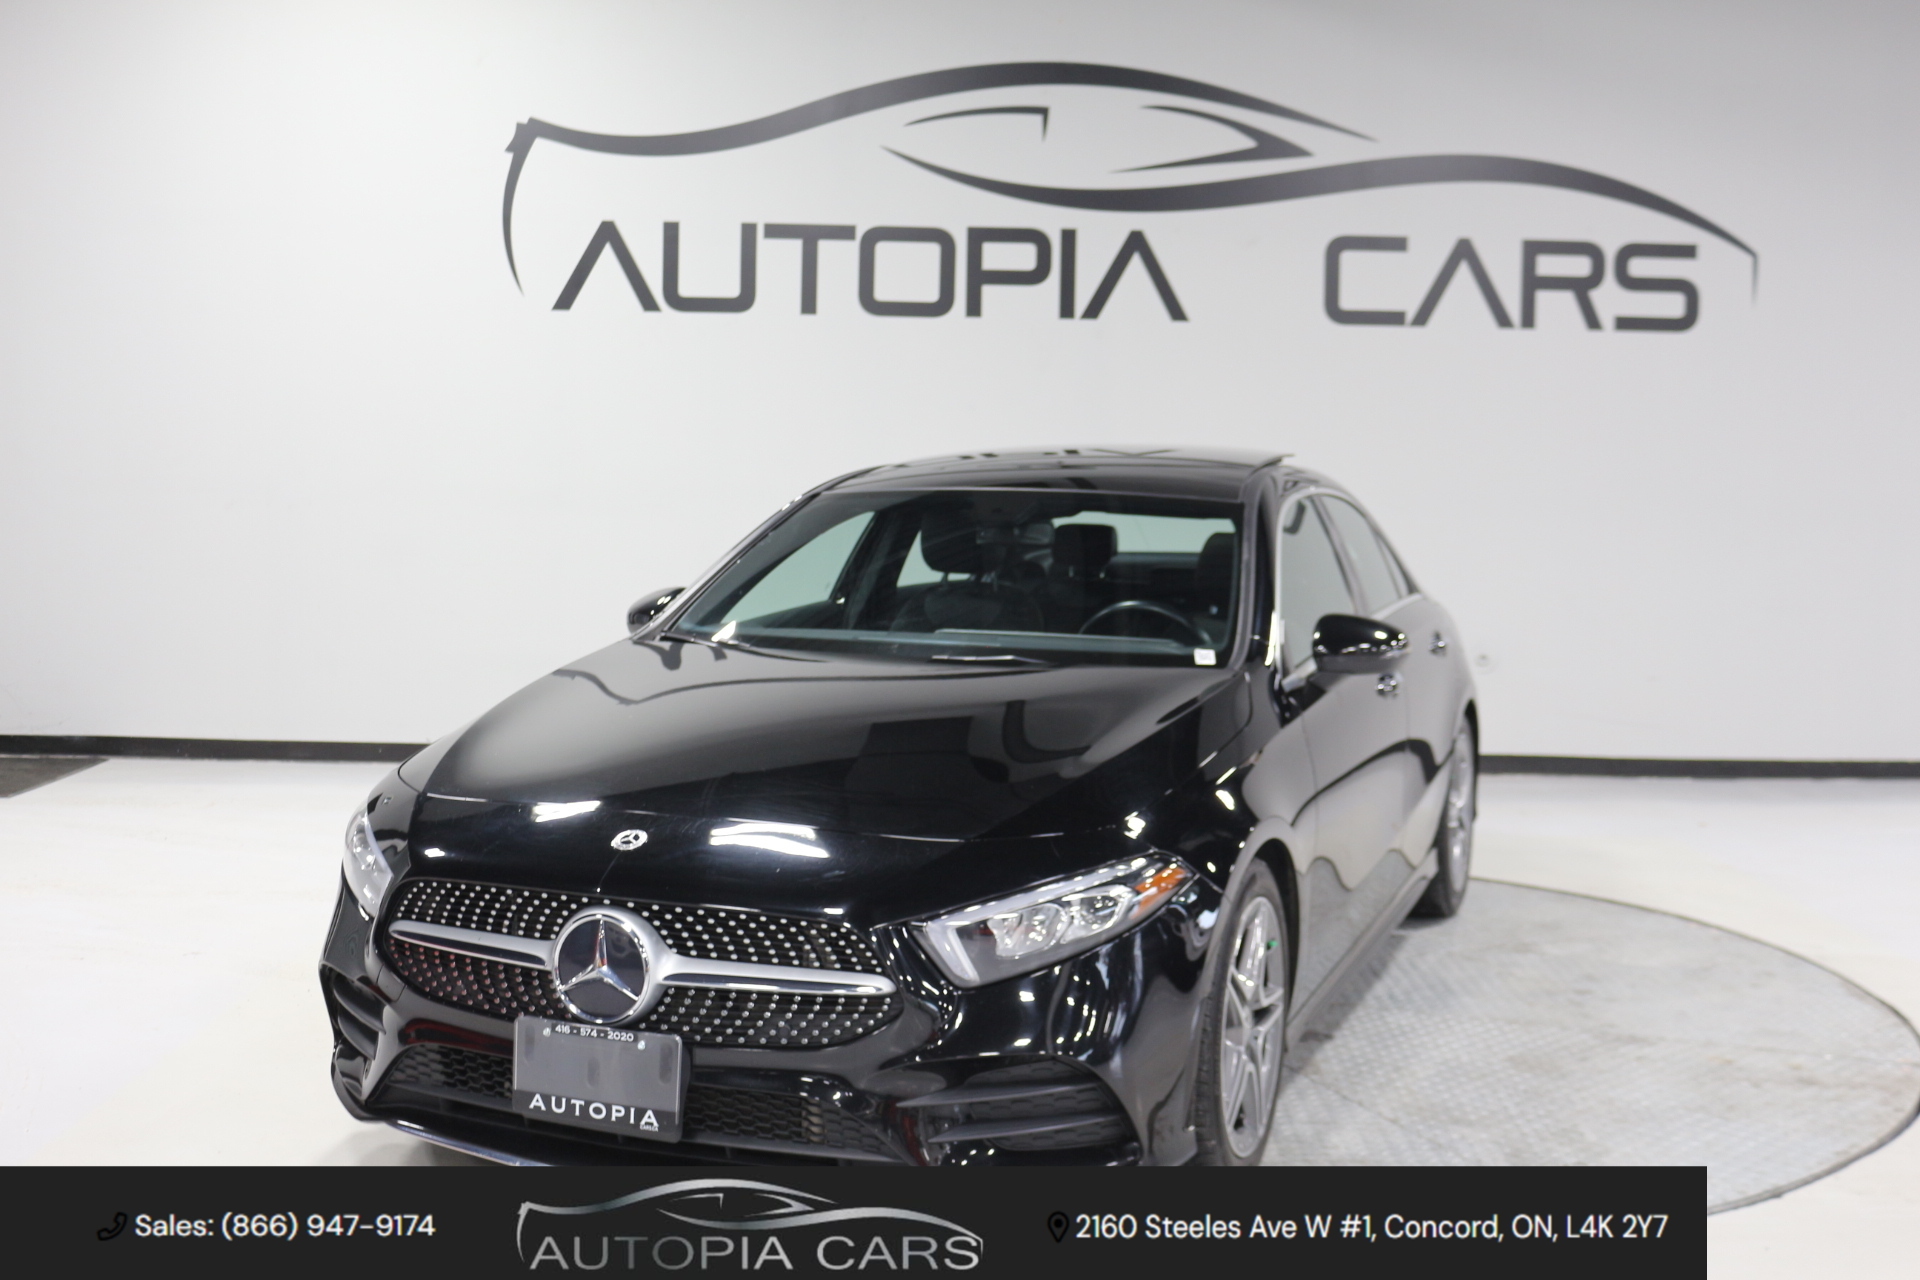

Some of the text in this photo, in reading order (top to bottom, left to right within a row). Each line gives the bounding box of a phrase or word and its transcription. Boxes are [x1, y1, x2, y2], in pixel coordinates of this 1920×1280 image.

[553, 220, 1701, 332] AUTOPIA CARS
[555, 1025, 570, 1034] 416
[580, 1028, 598, 1038] 574
[607, 1031, 634, 1042] 2020
[528, 1093, 659, 1126] AUTOPIA
